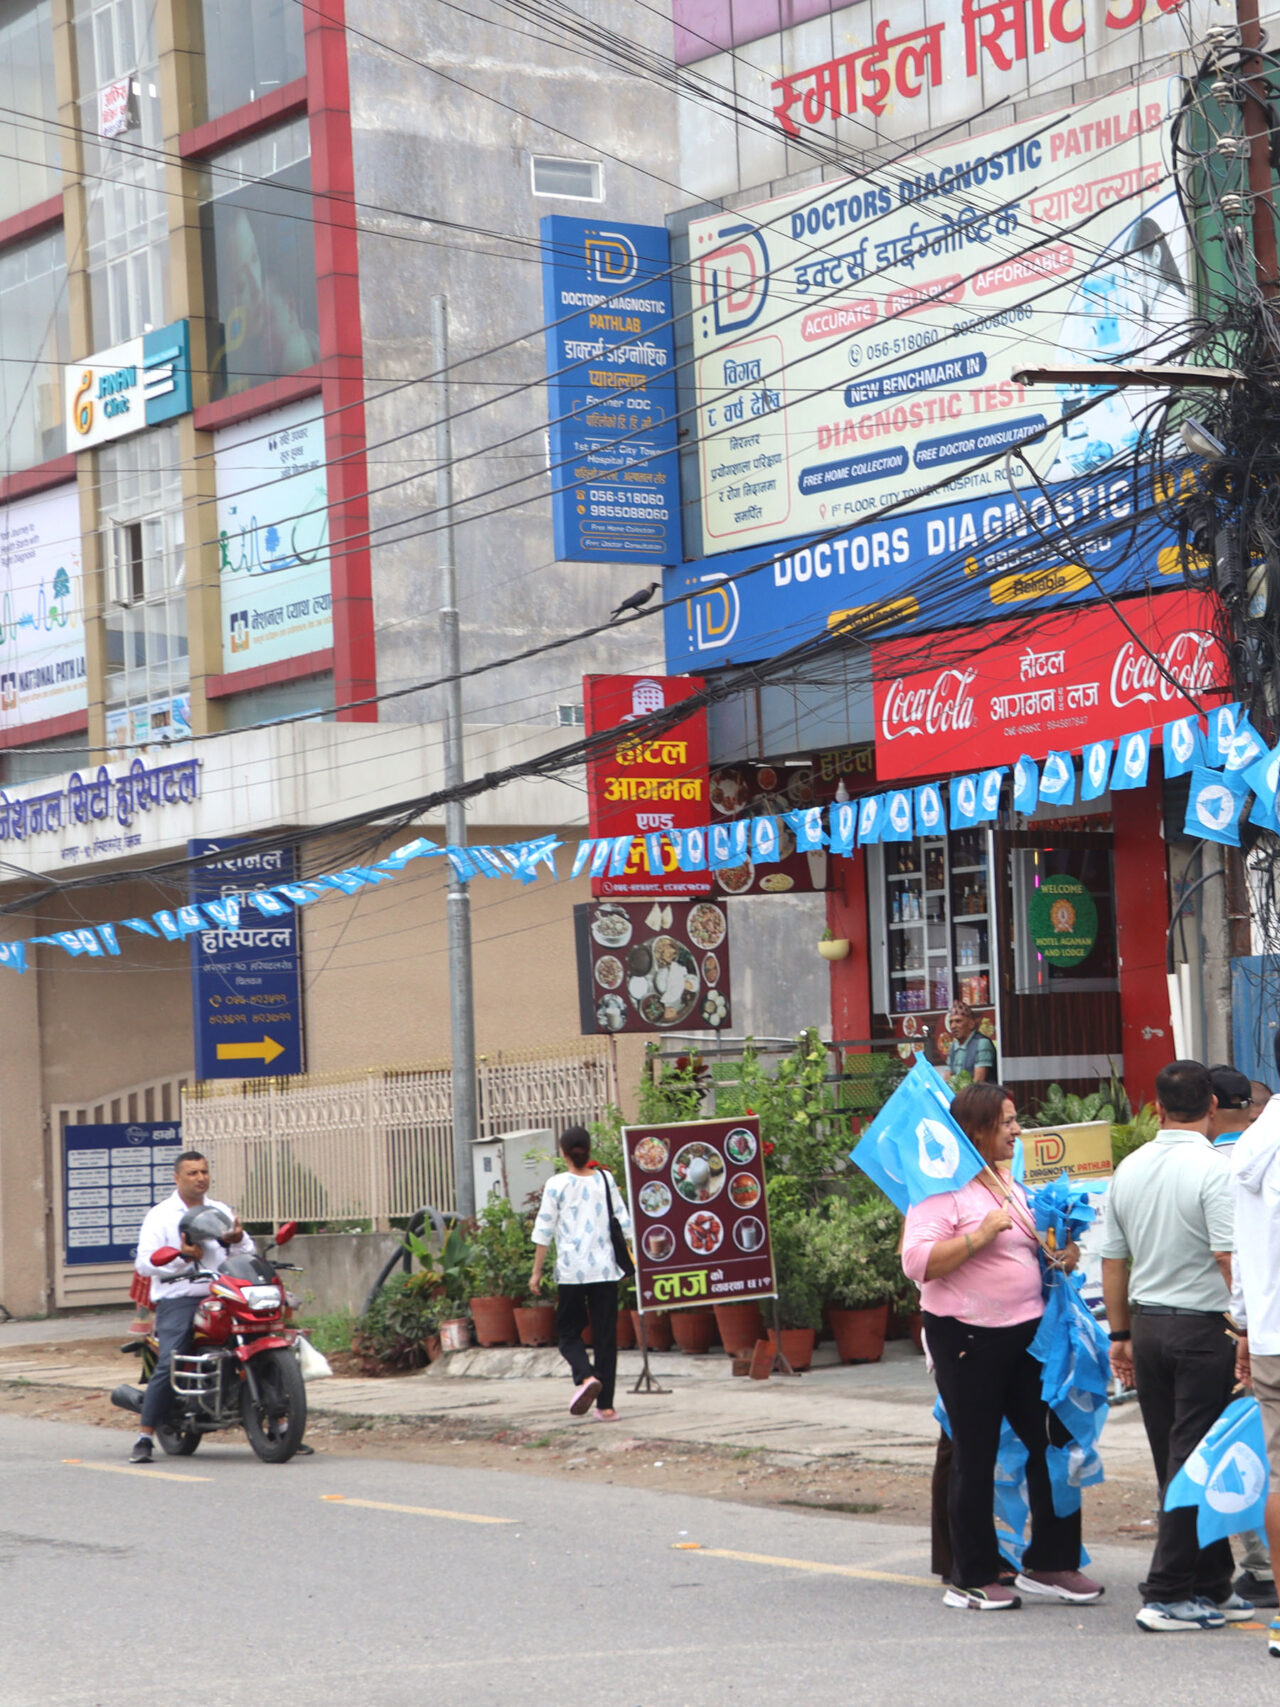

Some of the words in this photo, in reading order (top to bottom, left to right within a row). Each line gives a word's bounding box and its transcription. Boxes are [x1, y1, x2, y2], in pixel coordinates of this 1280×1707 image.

[771, 19, 946, 139] स्माईल
[791, 186, 891, 239] DOCTORS
[899, 139, 1043, 205] DIAGNOSTIC
[1050, 102, 1163, 163] PATHLAB
[1029, 161, 1164, 227] प्याथल्याब
[561, 291, 607, 308] DOCTORS
[608, 296, 666, 314] DIAGNOSTIC
[805, 304, 872, 337] ACCURATE
[976, 248, 1070, 291] AFFORDABLE
[589, 313, 642, 333] PATHLAB
[867, 329, 939, 360] 056-518060
[850, 381, 879, 404] NEW
[882, 364, 963, 397] BENCHMARK
[966, 356, 981, 375] IN
[627, 398, 652, 410] DDC
[724, 396, 743, 422] वर्ष
[817, 393, 963, 451] DIAGNOSTIC
[969, 379, 1027, 414] TEST
[587, 455, 624, 466] Hospital
[802, 472, 823, 488] FREE
[824, 466, 849, 483] HOME
[851, 454, 903, 477] COLLECTION
[915, 447, 938, 463] FREE
[939, 438, 975, 459] DOCTOR
[976, 422, 1046, 450] CONSULTATION
[590, 490, 665, 506] 056-518060
[880, 491, 899, 507] CITY
[942, 475, 992, 494] HOSPITAL
[994, 464, 1024, 482] ROAD
[590, 505, 669, 520] 9855088060
[773, 526, 910, 587] DOCTORS
[926, 479, 1131, 557] DIAGNOSTIC
[19, 664, 56, 691] NATIONAL
[56, 658, 74, 681] PATH
[1019, 647, 1066, 682] होटल
[990, 688, 1056, 721] आगमन
[1066, 682, 1100, 709] लज
[615, 732, 689, 766] होटल
[68, 765, 112, 825] सिटी
[115, 757, 200, 827] हस्पिटल
[604, 777, 703, 801] आगमन
[1041, 884, 1083, 894] WELCOME
[1045, 948, 1060, 957] AND
[1029, 1165, 1075, 1178] DIAGNOSTIC
[652, 1270, 708, 1301] लज
